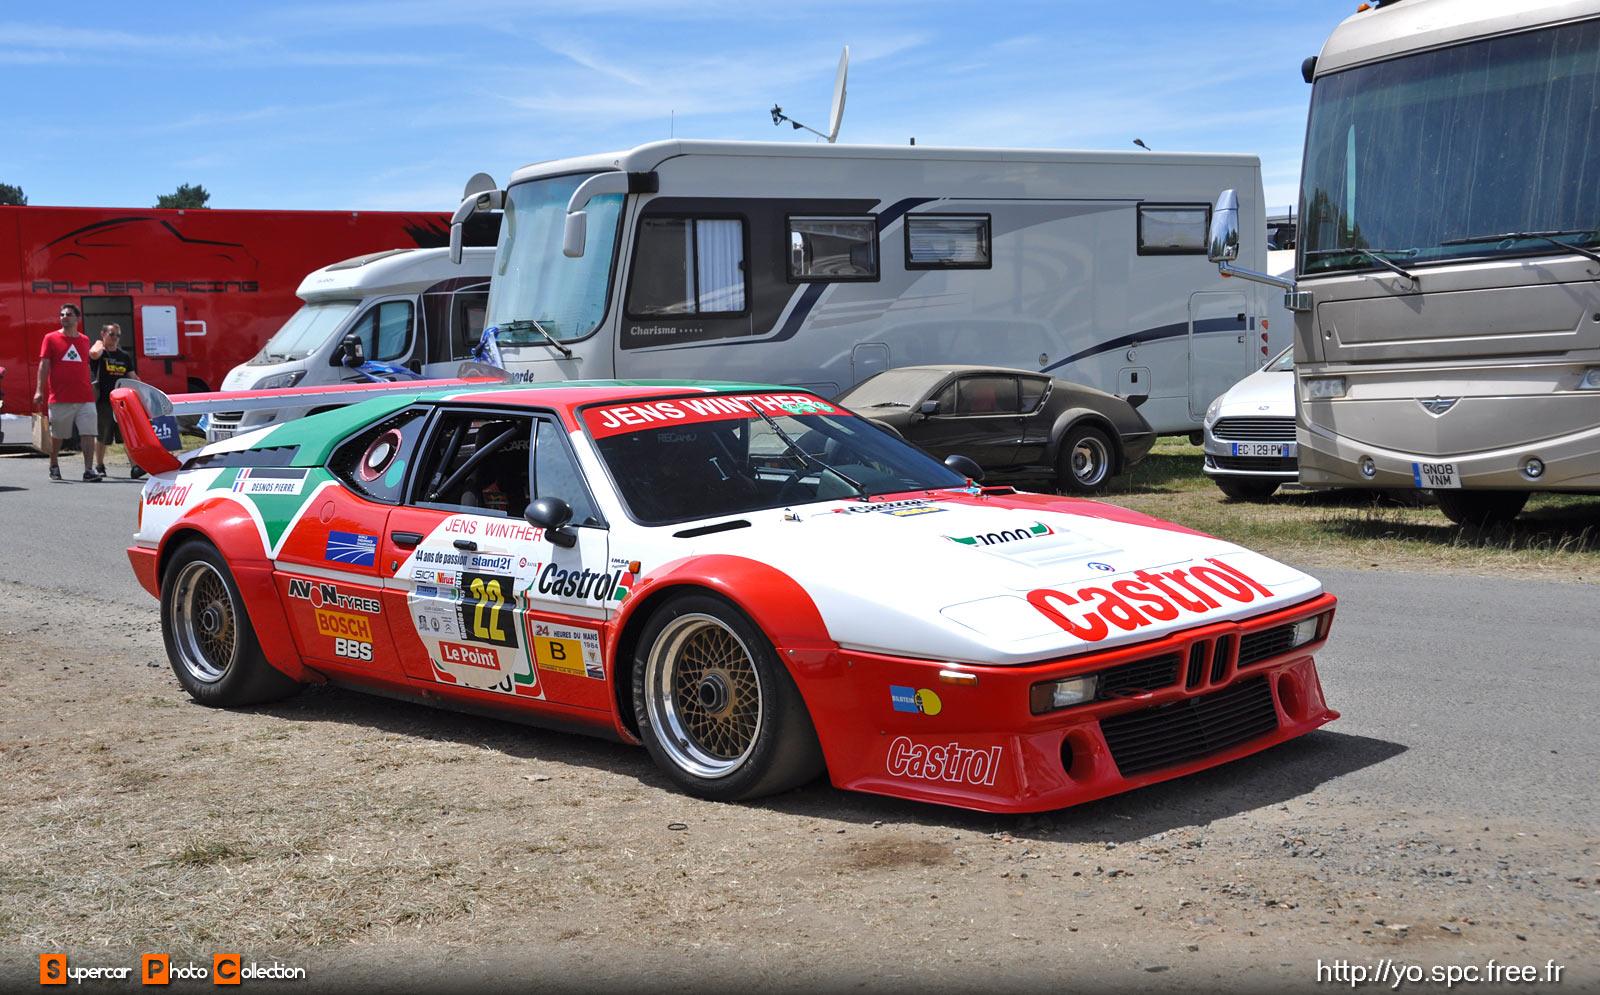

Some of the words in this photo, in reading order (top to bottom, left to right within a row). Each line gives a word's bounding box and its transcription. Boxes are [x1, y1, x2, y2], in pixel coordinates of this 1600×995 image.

[154, 280, 259, 294] RACING
[630, 325, 677, 336] Charisma
[599, 402, 686, 429] JENS
[680, 395, 828, 417] WINTHER
[1422, 463, 1454, 475] GN08
[1428, 474, 1452, 485] VNM
[146, 482, 193, 507] Castrol
[251, 482, 274, 492] DESNOS
[274, 483, 296, 492] PIERRE
[445, 518, 478, 535] JENS
[485, 522, 544, 542] WINTHER
[423, 552, 434, 563] ans
[435, 552, 443, 564] de
[443, 553, 468, 566] passion
[414, 570, 435, 579] SICA
[538, 562, 622, 601] Castrol
[288, 578, 338, 608] AVON
[336, 595, 381, 614] TYRES
[1026, 557, 1275, 642] Castrol
[469, 577, 506, 642] 22
[318, 613, 370, 639] BOSCH
[535, 625, 550, 636] 24
[553, 630, 572, 639] HEURES
[573, 631, 581, 639] DU
[583, 632, 598, 640] MANS
[335, 637, 374, 661] BBS
[444, 645, 460, 660] Le
[460, 646, 496, 667] Point
[549, 641, 567, 660] B
[886, 736, 1002, 786] Castrol
